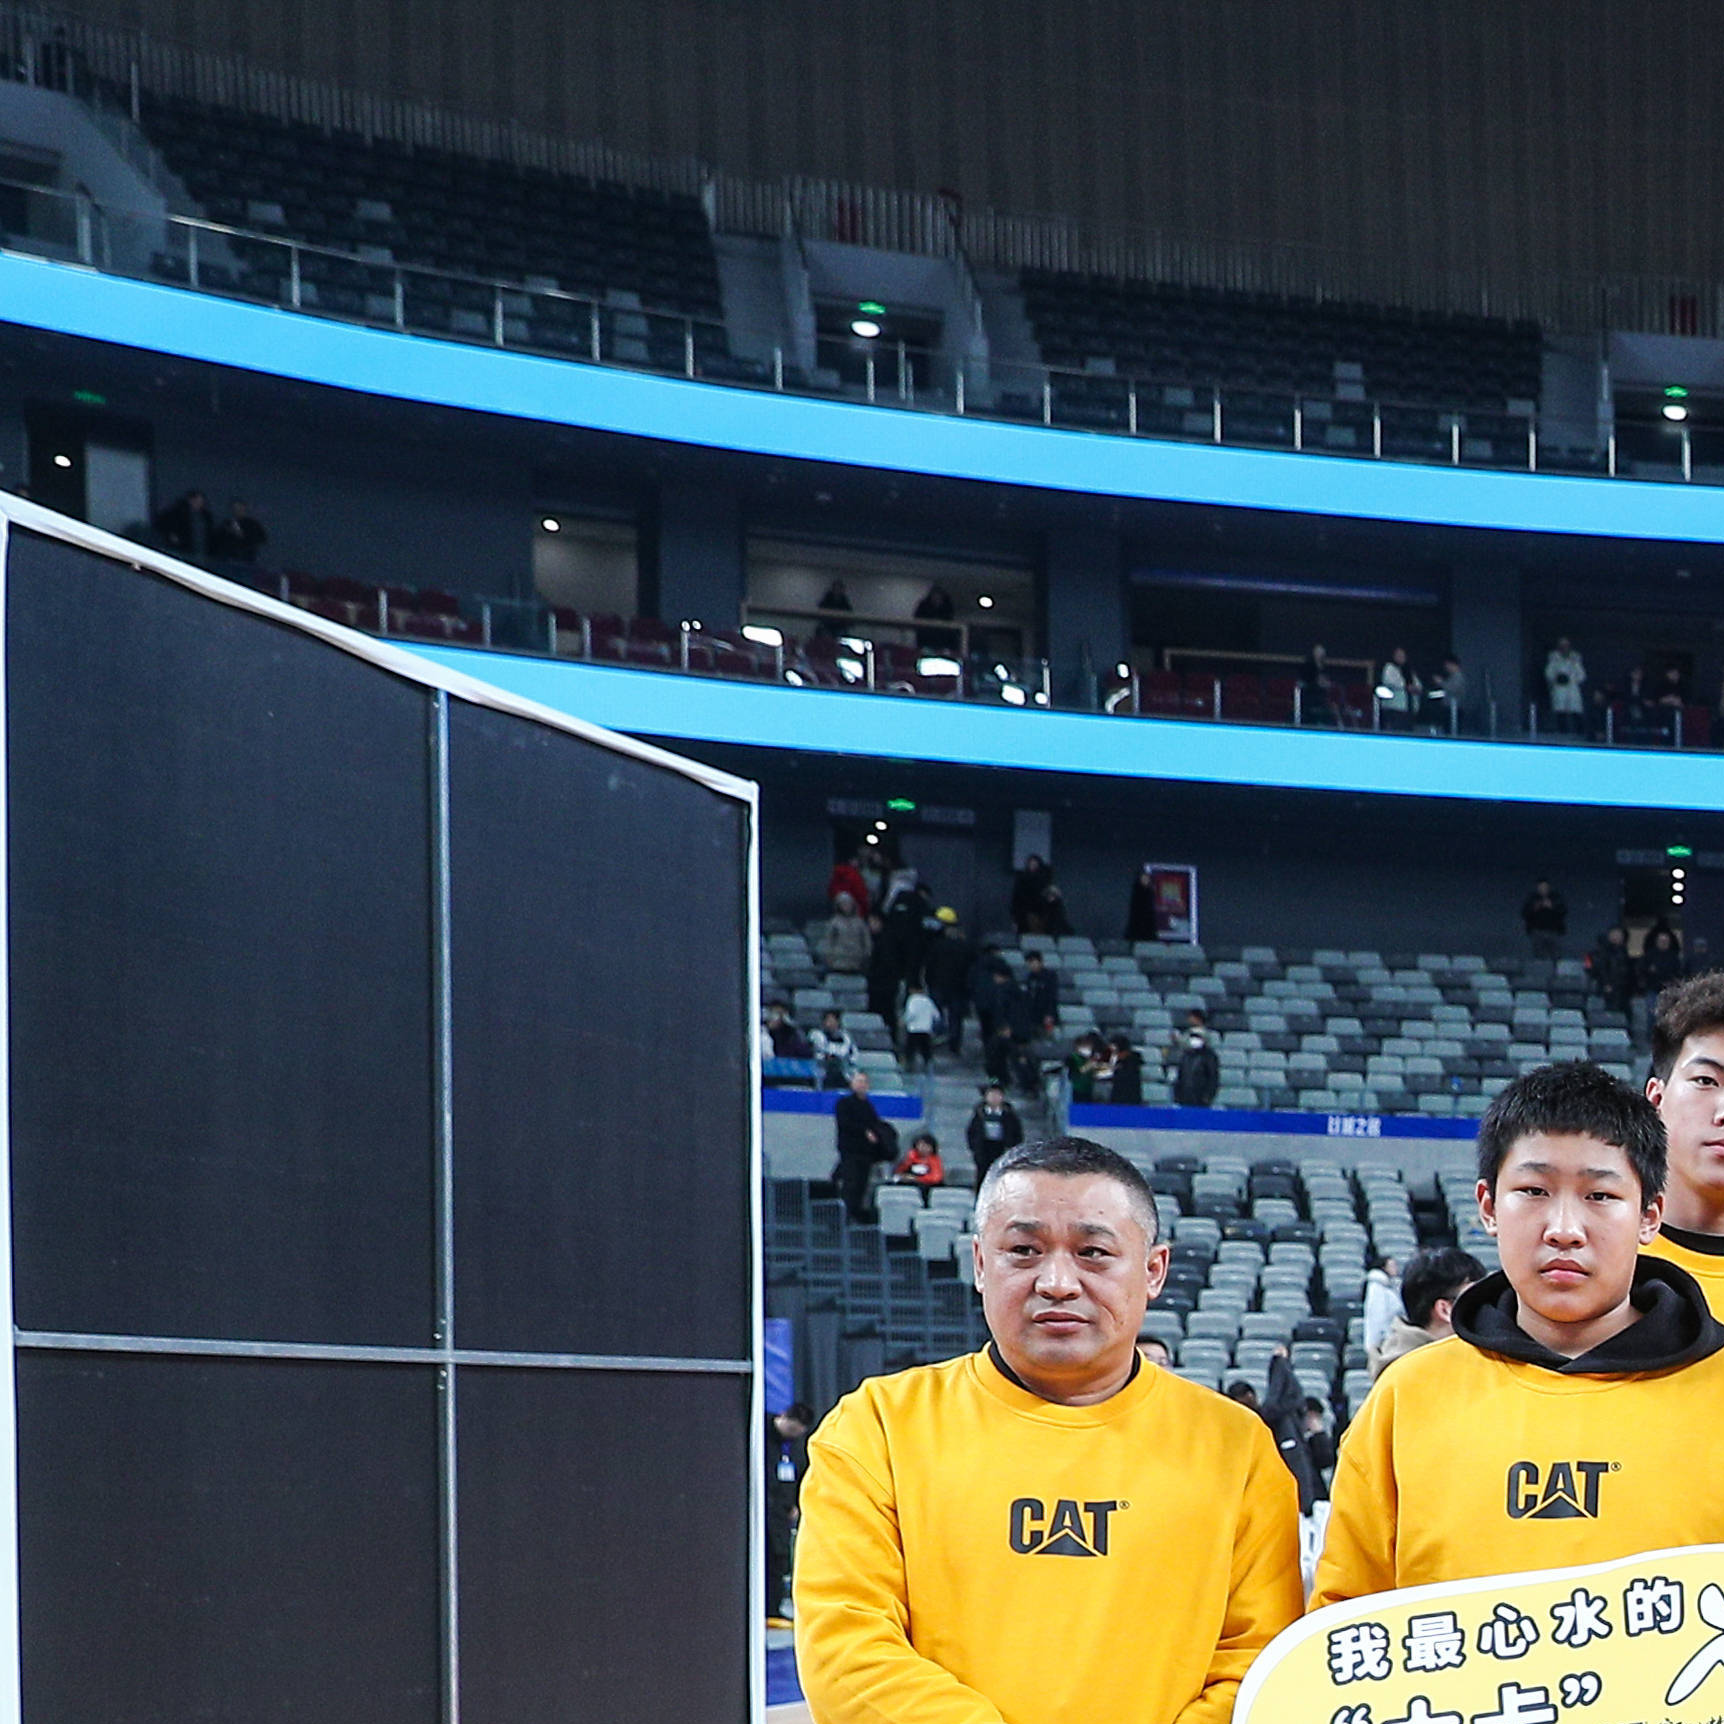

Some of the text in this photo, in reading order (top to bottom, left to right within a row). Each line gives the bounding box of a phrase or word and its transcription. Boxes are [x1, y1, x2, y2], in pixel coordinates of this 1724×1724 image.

[1508, 1461, 1611, 1519] CAT
[1009, 1498, 1117, 1557] CAT
[1326, 1576, 1685, 1686] 我最心水的
